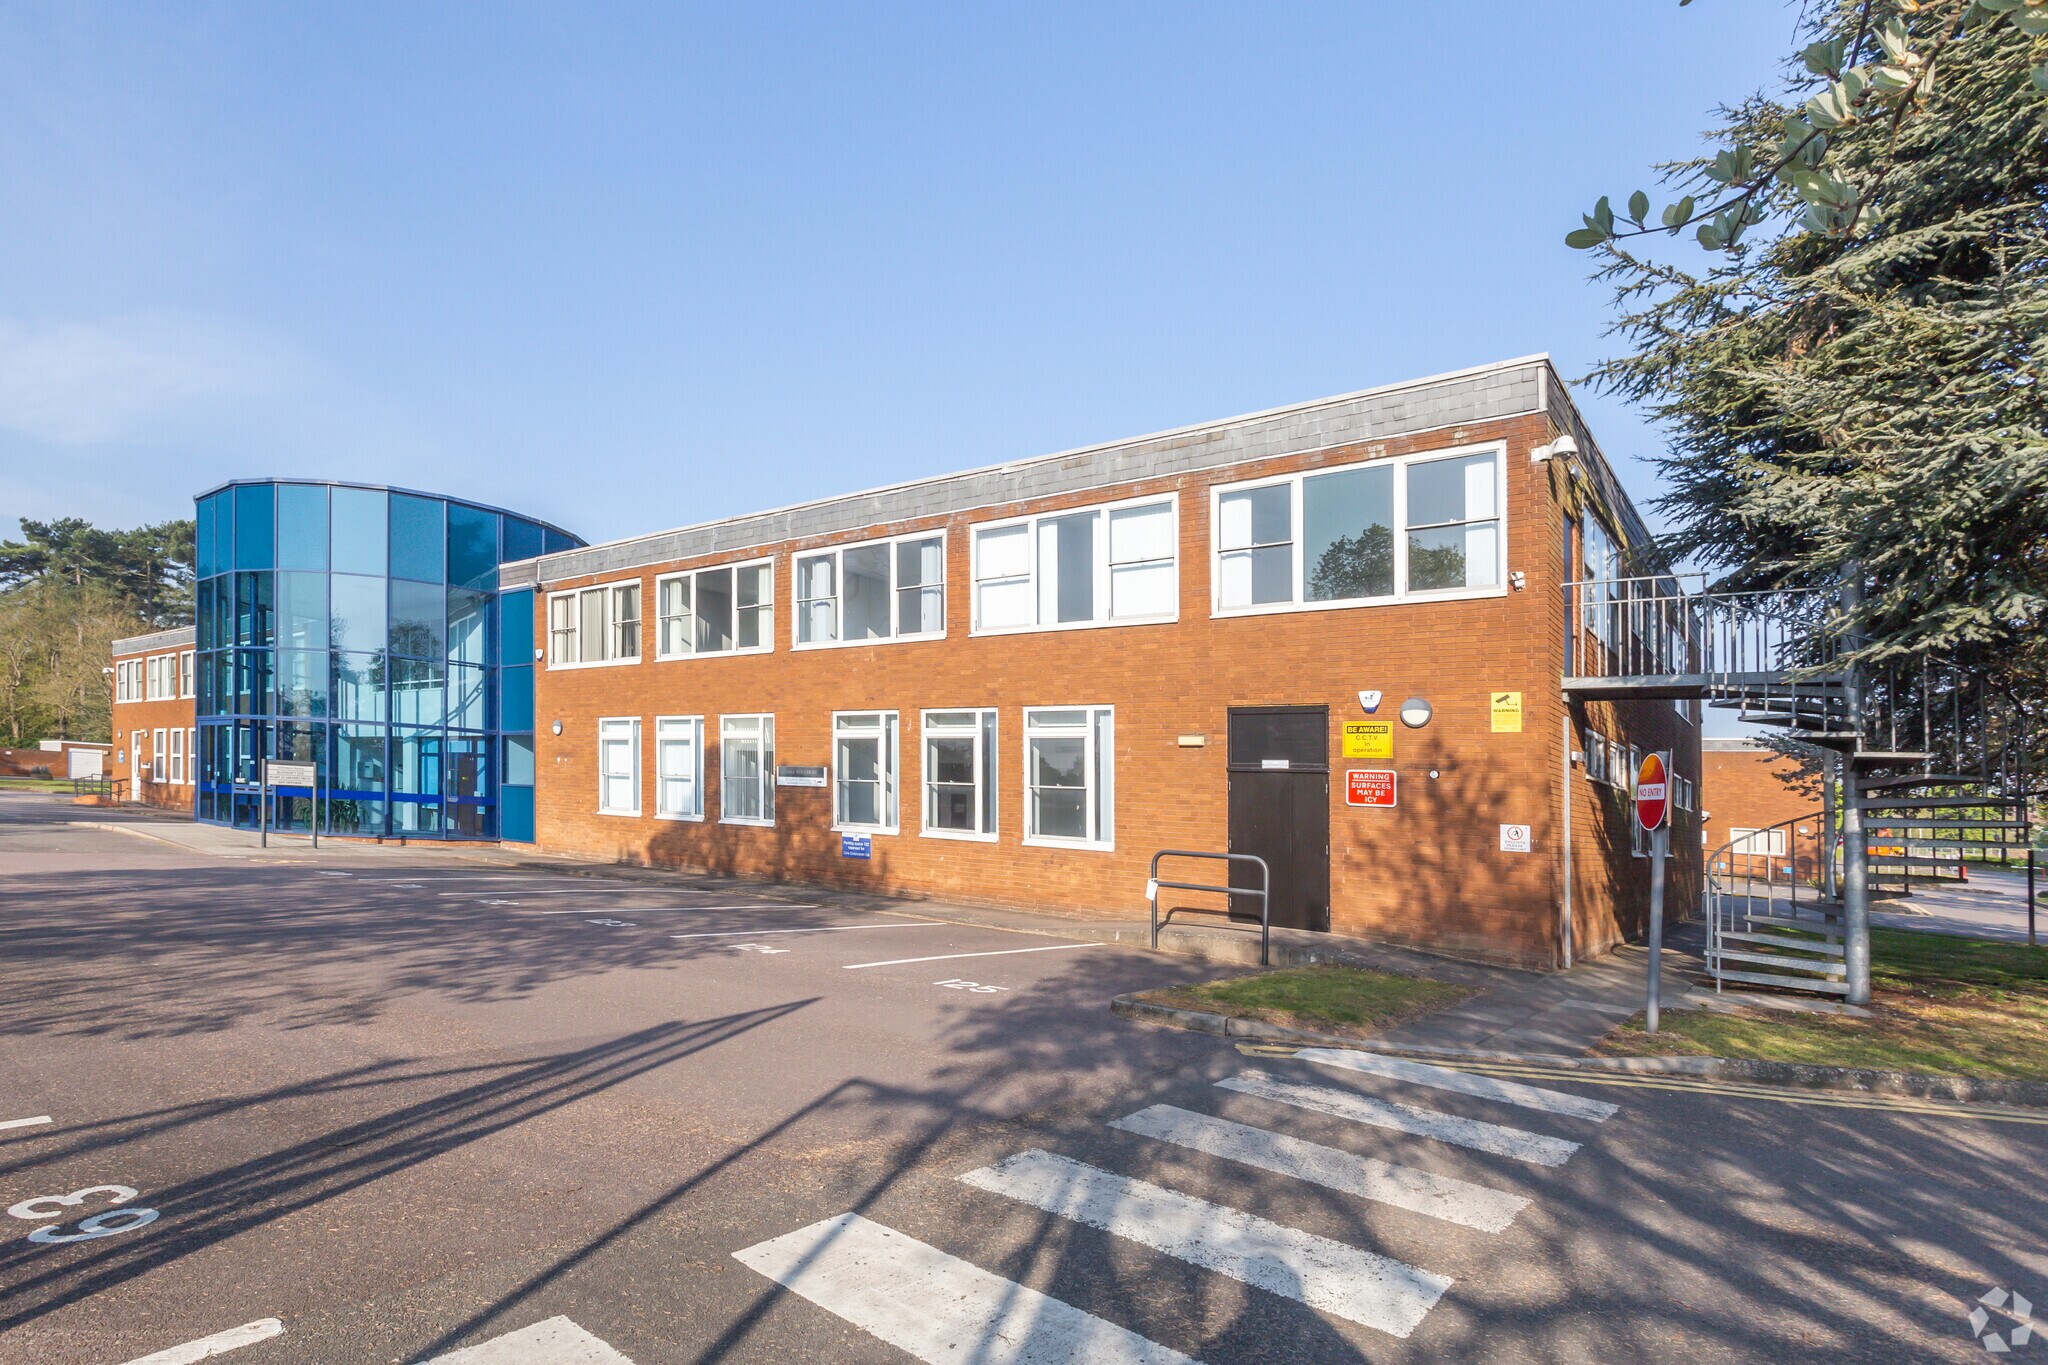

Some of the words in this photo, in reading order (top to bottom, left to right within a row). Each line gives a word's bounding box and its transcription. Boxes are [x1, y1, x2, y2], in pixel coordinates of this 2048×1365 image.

[1351, 782, 1392, 790] SURFACES
[1639, 788, 1646, 797] NO
[1648, 788, 1662, 796] ENTRY
[933, 978, 1010, 993] 125
